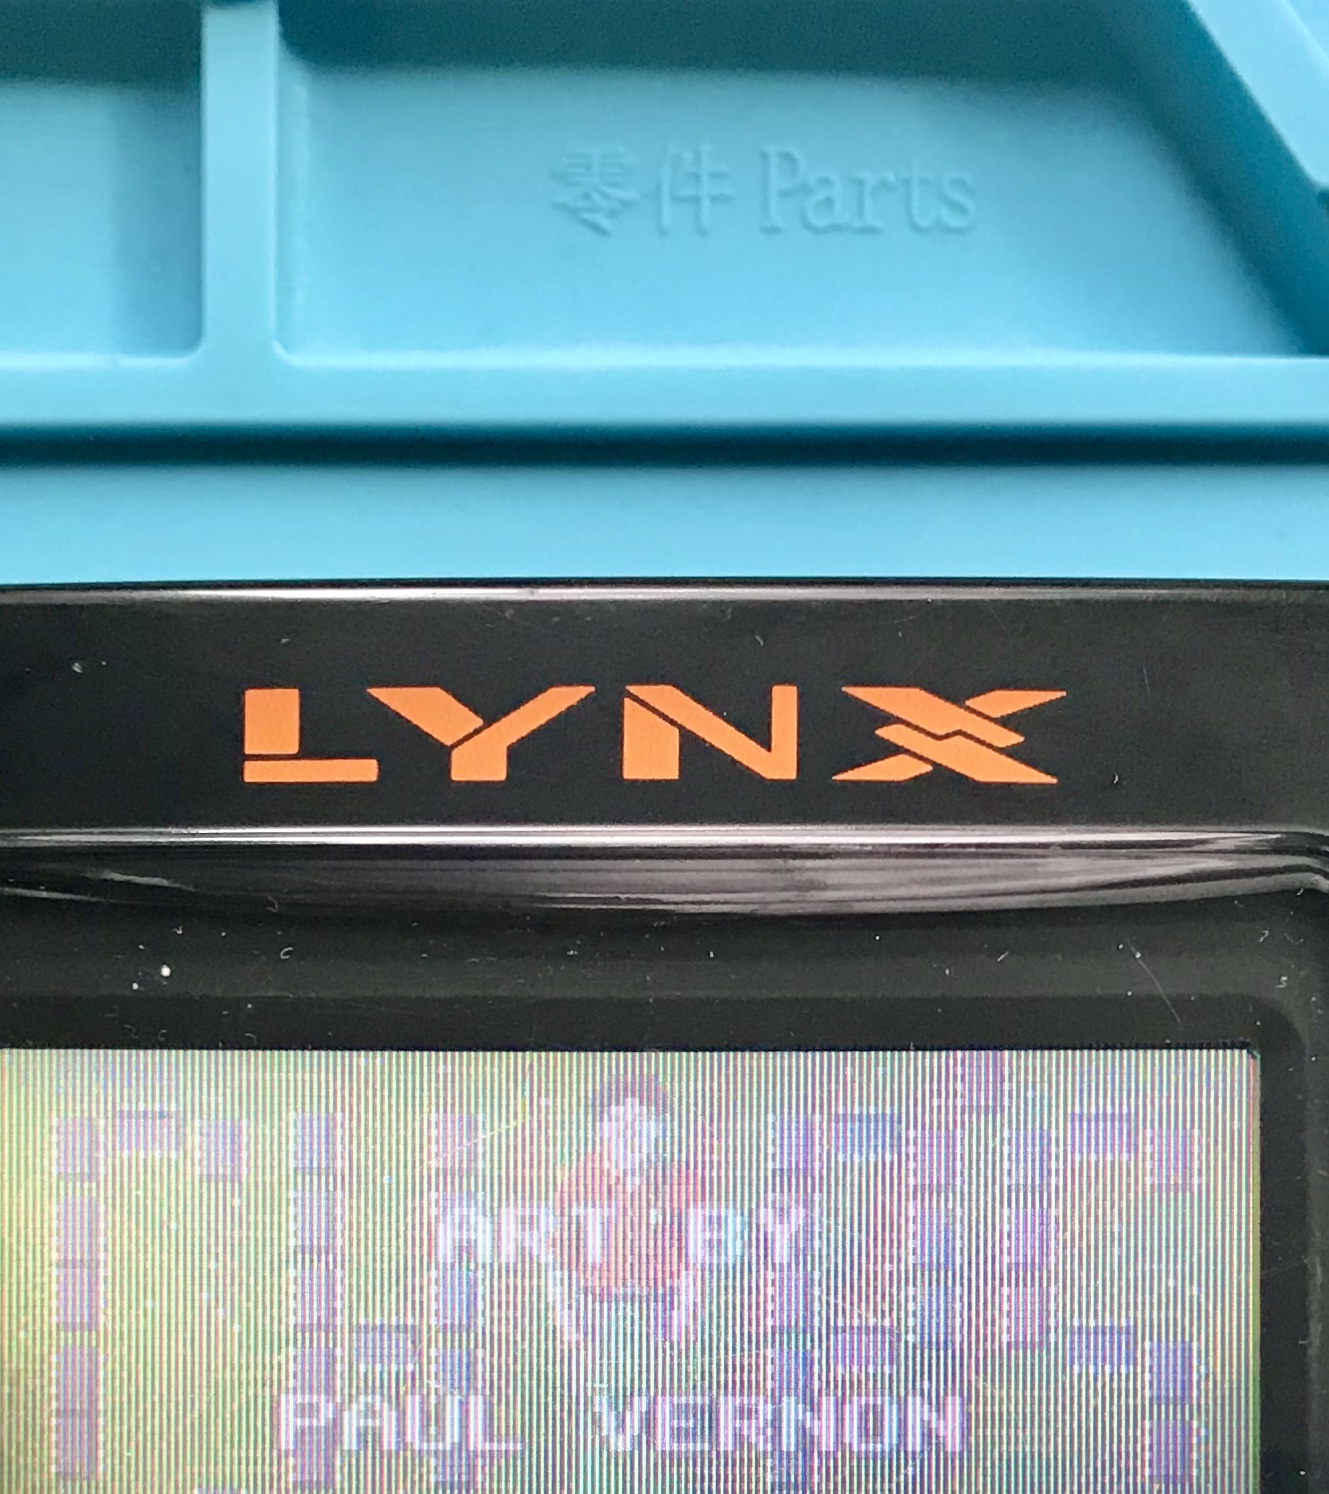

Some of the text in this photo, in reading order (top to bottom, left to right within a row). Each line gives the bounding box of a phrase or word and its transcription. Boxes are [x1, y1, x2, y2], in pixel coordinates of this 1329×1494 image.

[758, 145, 978, 236] Parts
[242, 685, 1068, 785] LYNX
[433, 1206, 810, 1265] ART BY
[279, 1395, 966, 1454] PAUL VERNON
